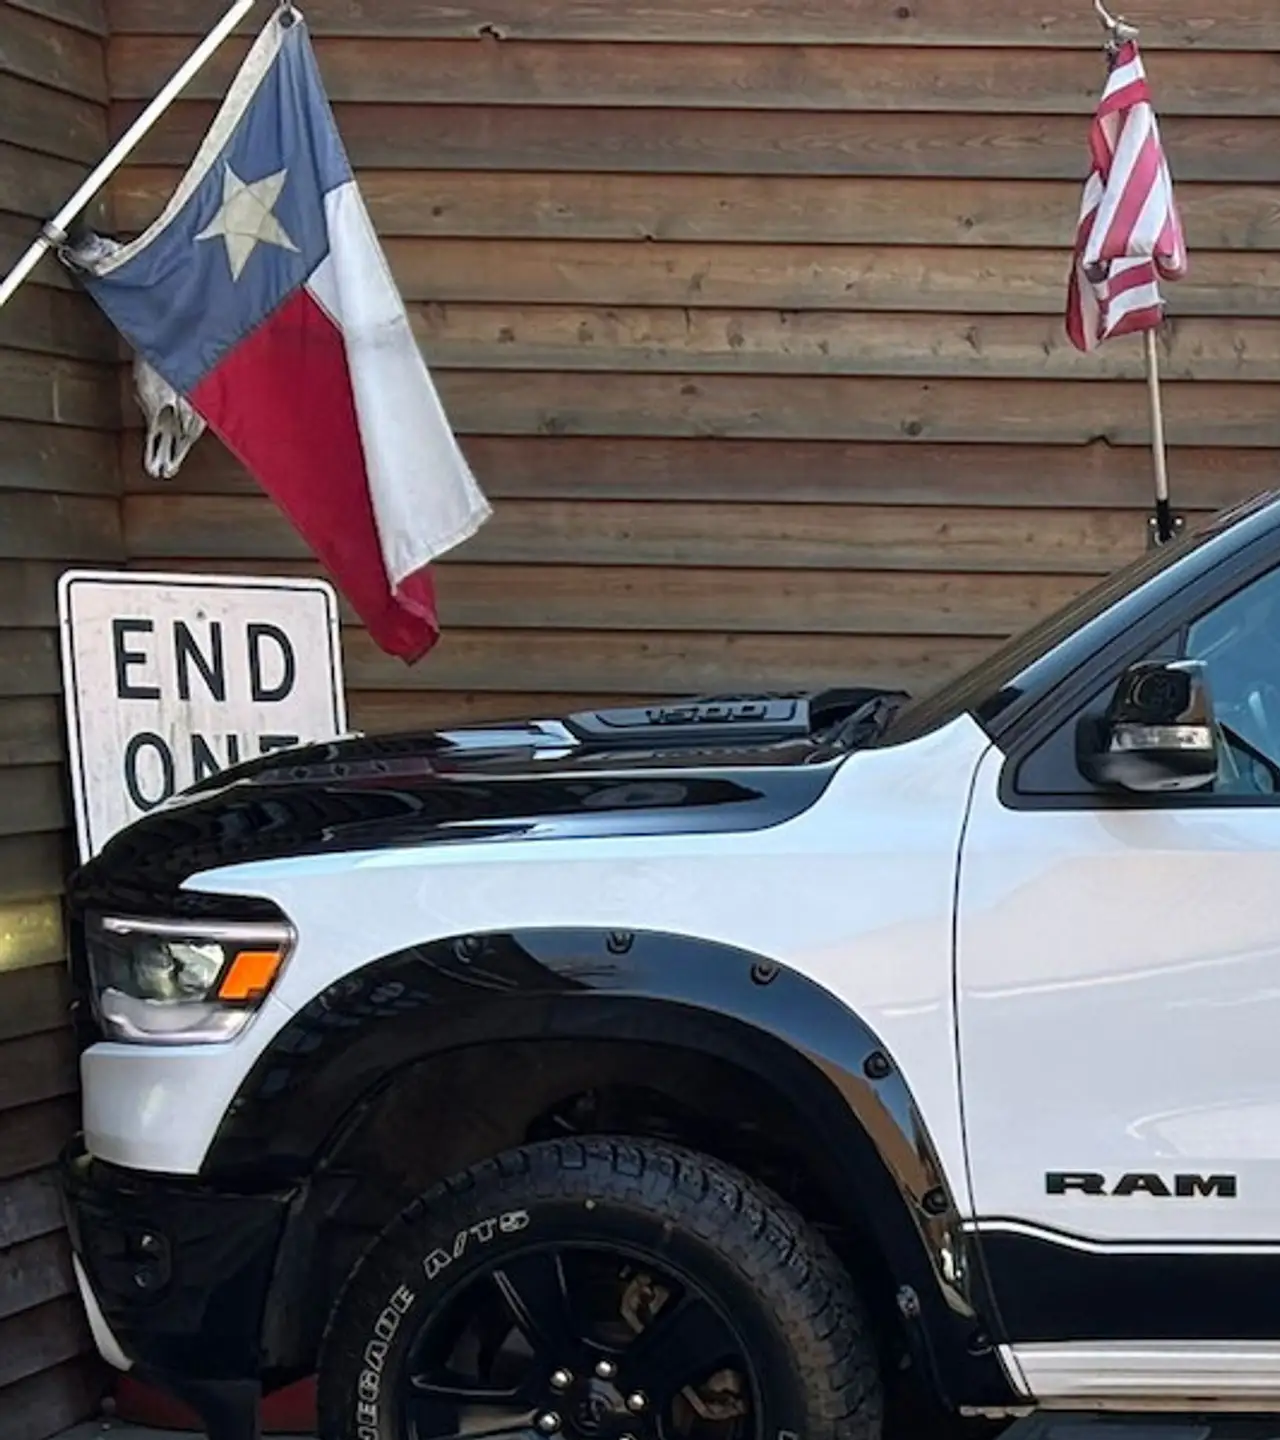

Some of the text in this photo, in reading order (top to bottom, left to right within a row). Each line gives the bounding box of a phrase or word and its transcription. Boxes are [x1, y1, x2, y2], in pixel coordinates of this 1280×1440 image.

[112, 618, 296, 703] END
[124, 731, 299, 813] ON
[1045, 1172, 1238, 1198] RAM
